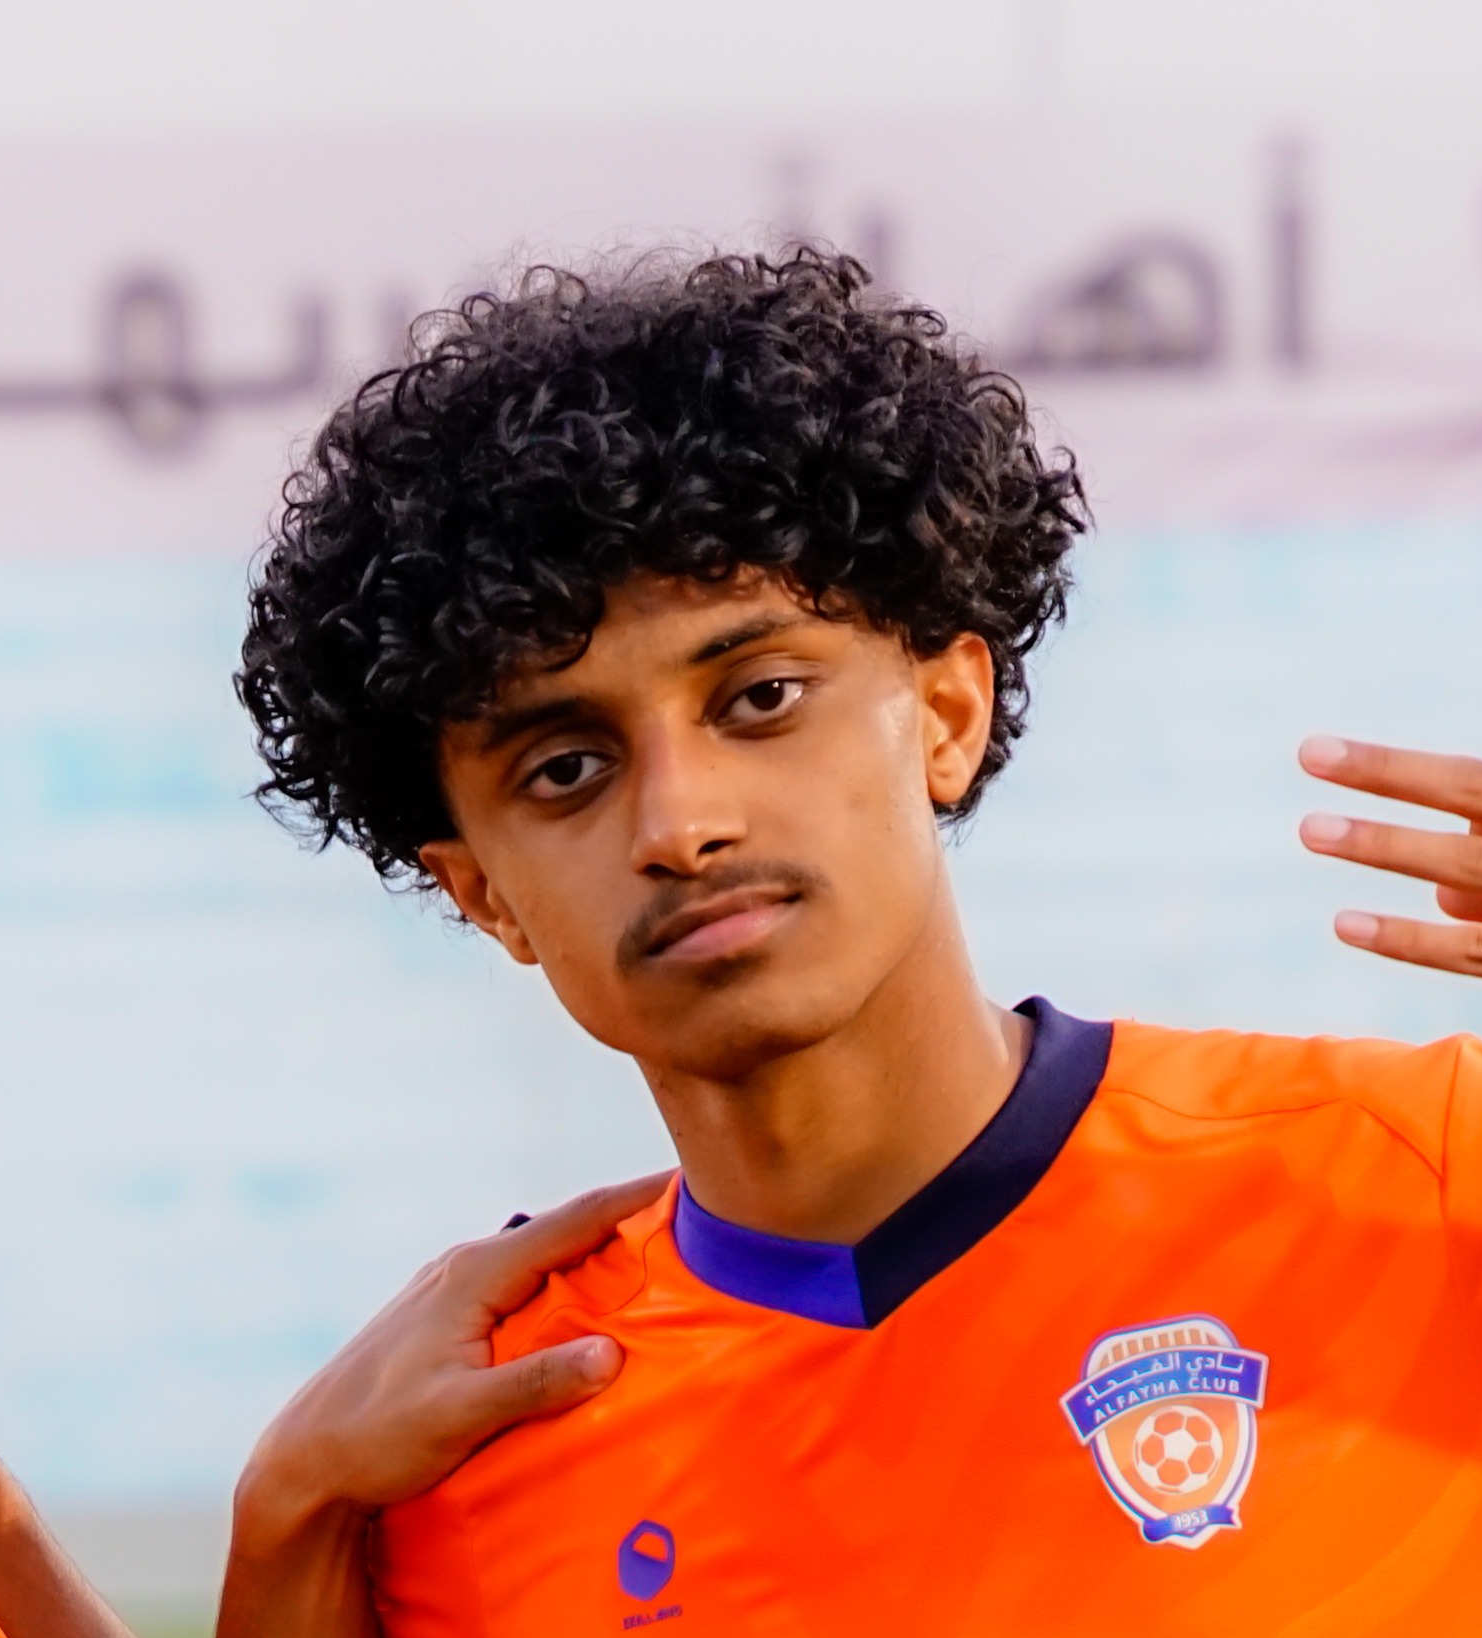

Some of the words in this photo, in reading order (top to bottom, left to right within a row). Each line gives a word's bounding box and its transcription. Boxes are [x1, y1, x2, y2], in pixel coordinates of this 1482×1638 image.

[1086, 1352, 1180, 1407] الفيحاء
[1186, 1352, 1245, 1378] نادي
[1094, 1378, 1180, 1424] ALFAYHA
[1188, 1376, 1240, 1393] CLUB
[1174, 1508, 1210, 1529] 1953
